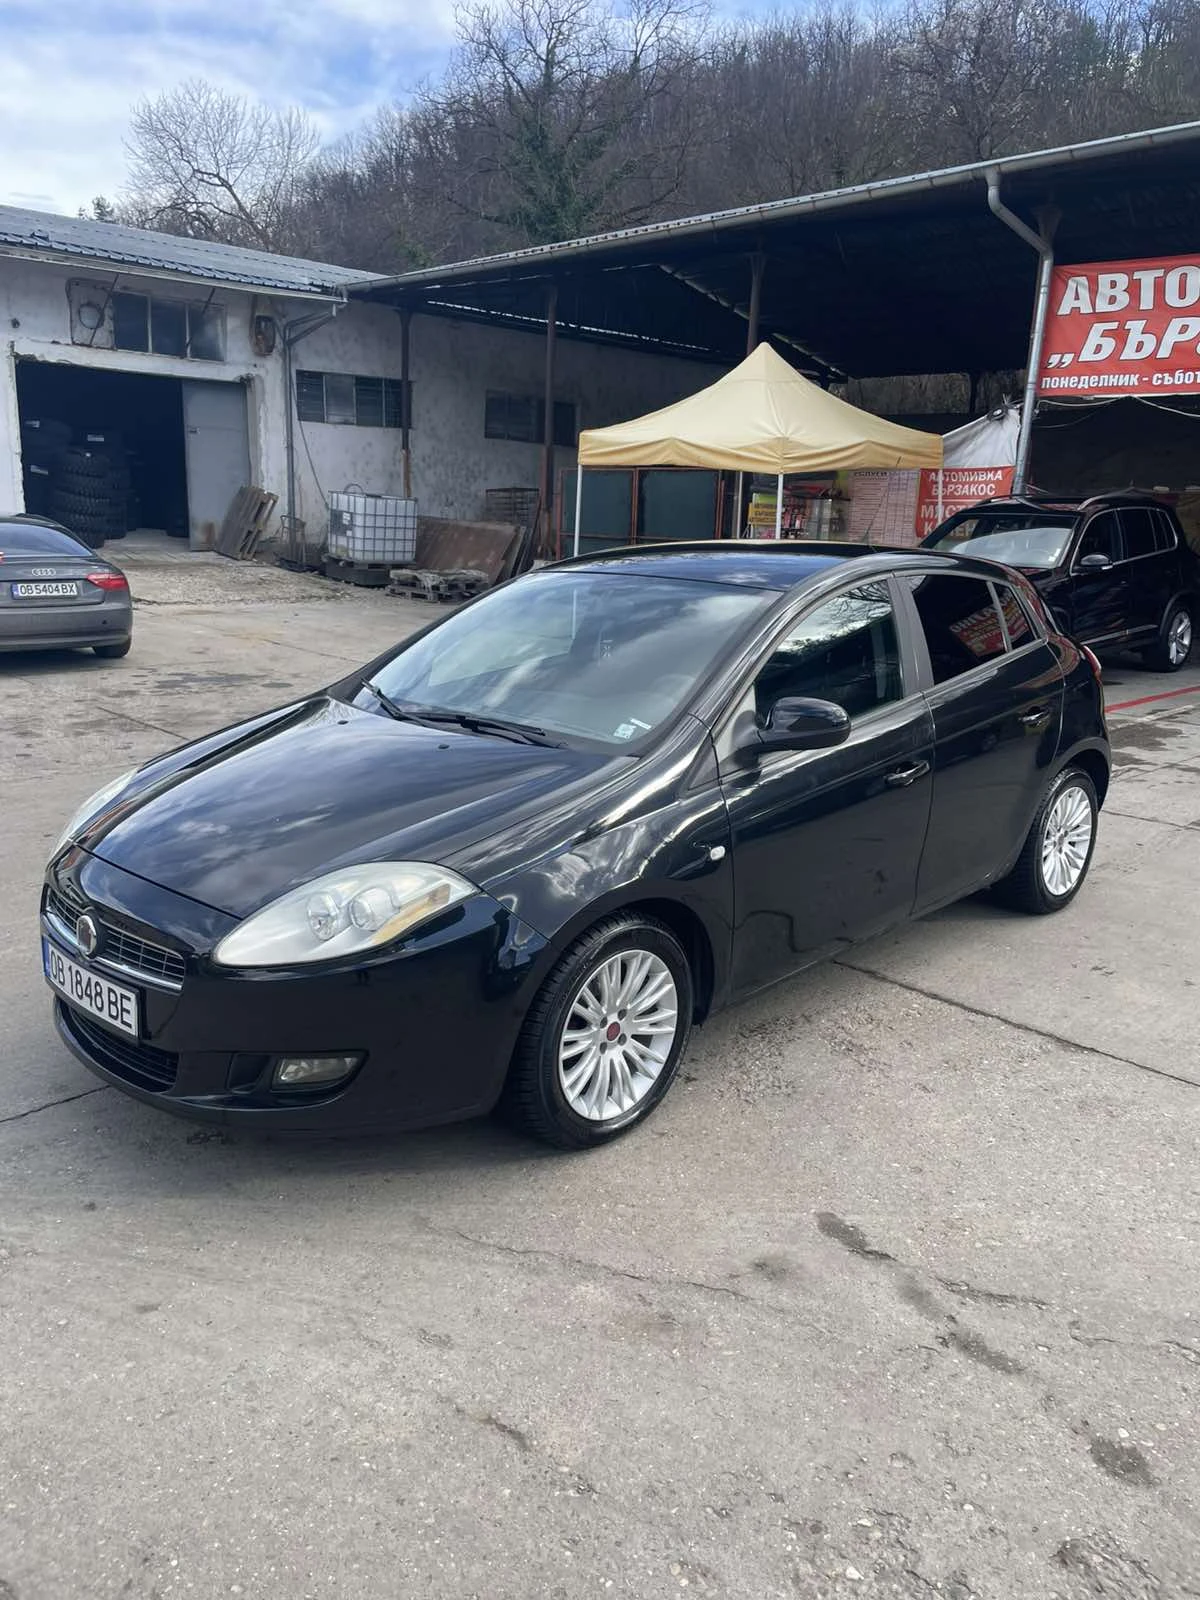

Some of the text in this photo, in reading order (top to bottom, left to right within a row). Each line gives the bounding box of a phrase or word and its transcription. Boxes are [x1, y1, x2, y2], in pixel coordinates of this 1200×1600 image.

[1046, 315, 1200, 368] „БЪР
[1041, 373, 1140, 389] понеделник
[50, 951, 132, 1029] OB 1848 BE
